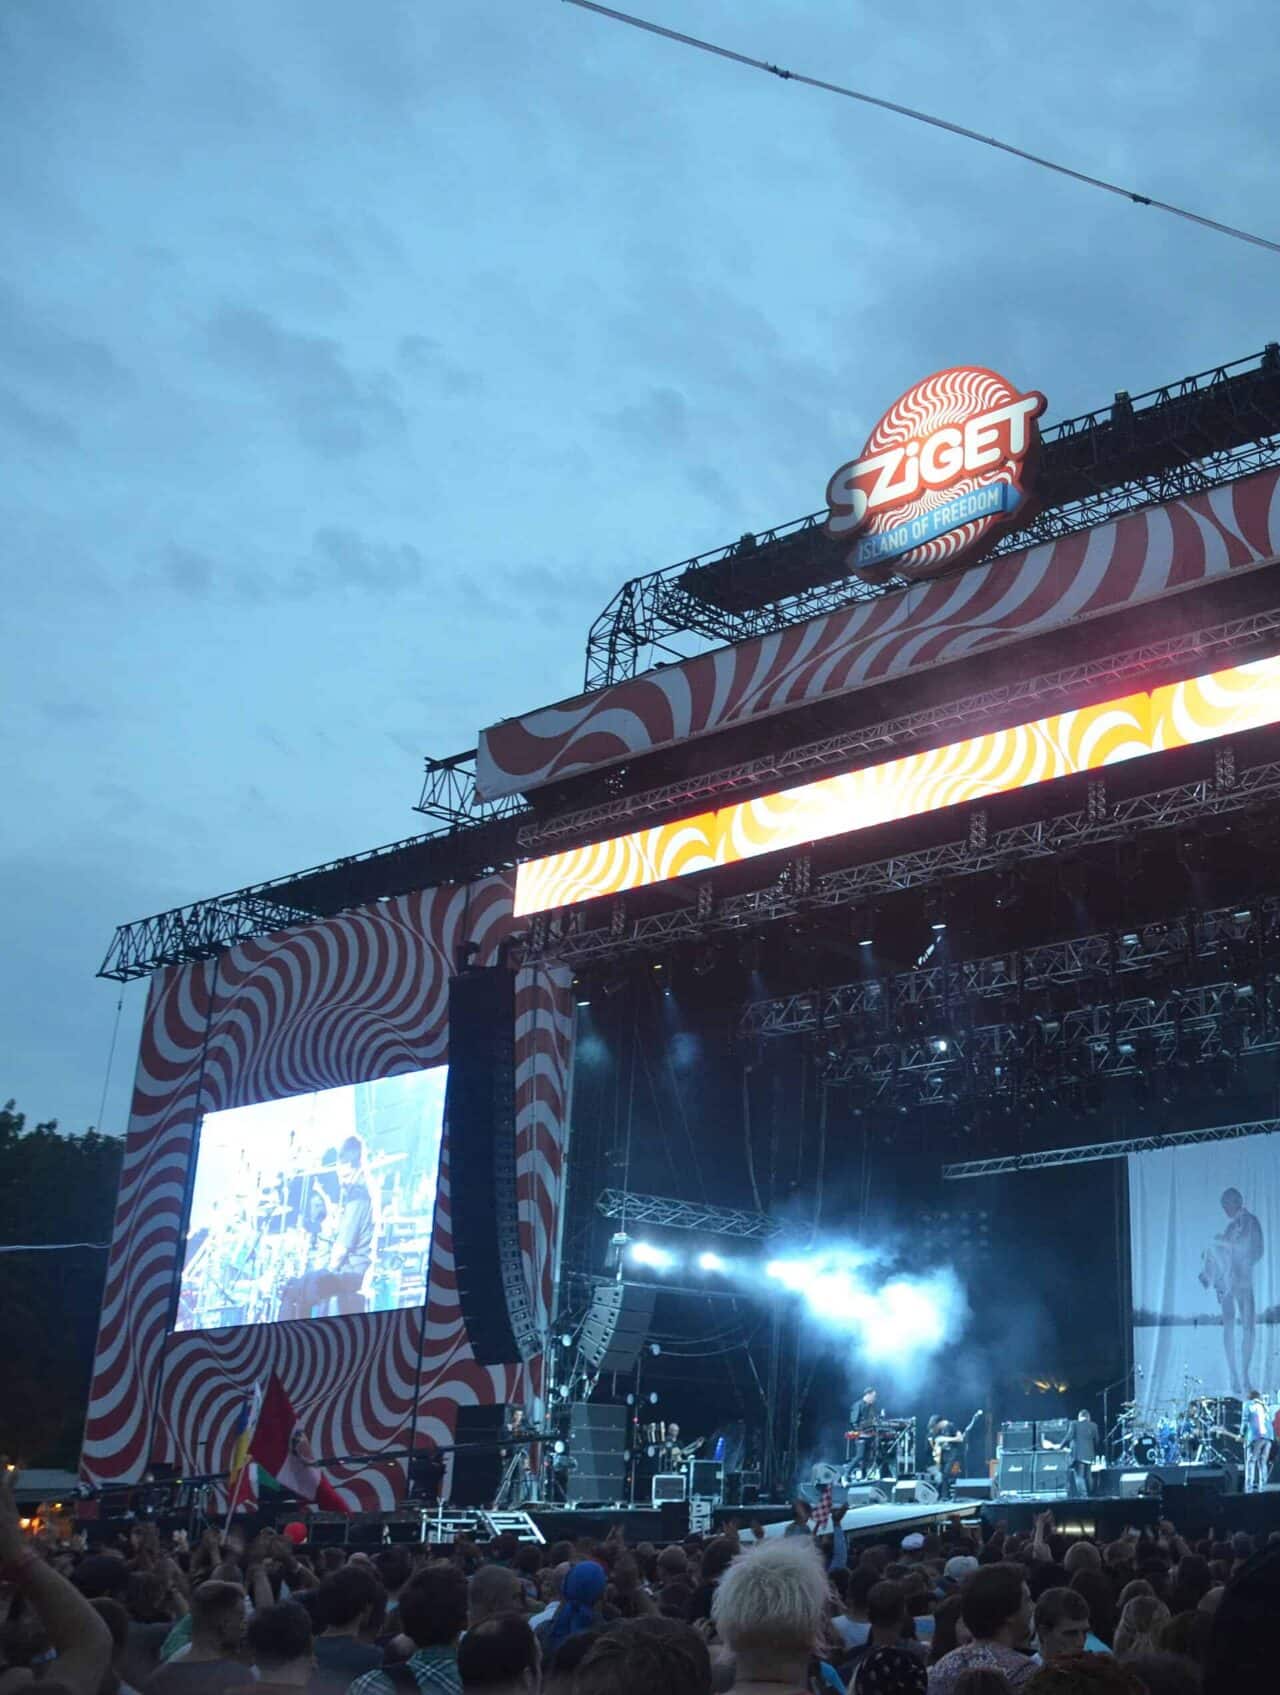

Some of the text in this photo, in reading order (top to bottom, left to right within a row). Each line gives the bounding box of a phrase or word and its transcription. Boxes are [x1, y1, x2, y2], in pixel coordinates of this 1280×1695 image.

[858, 487, 999, 561] ISLAND OF FREEDOM
